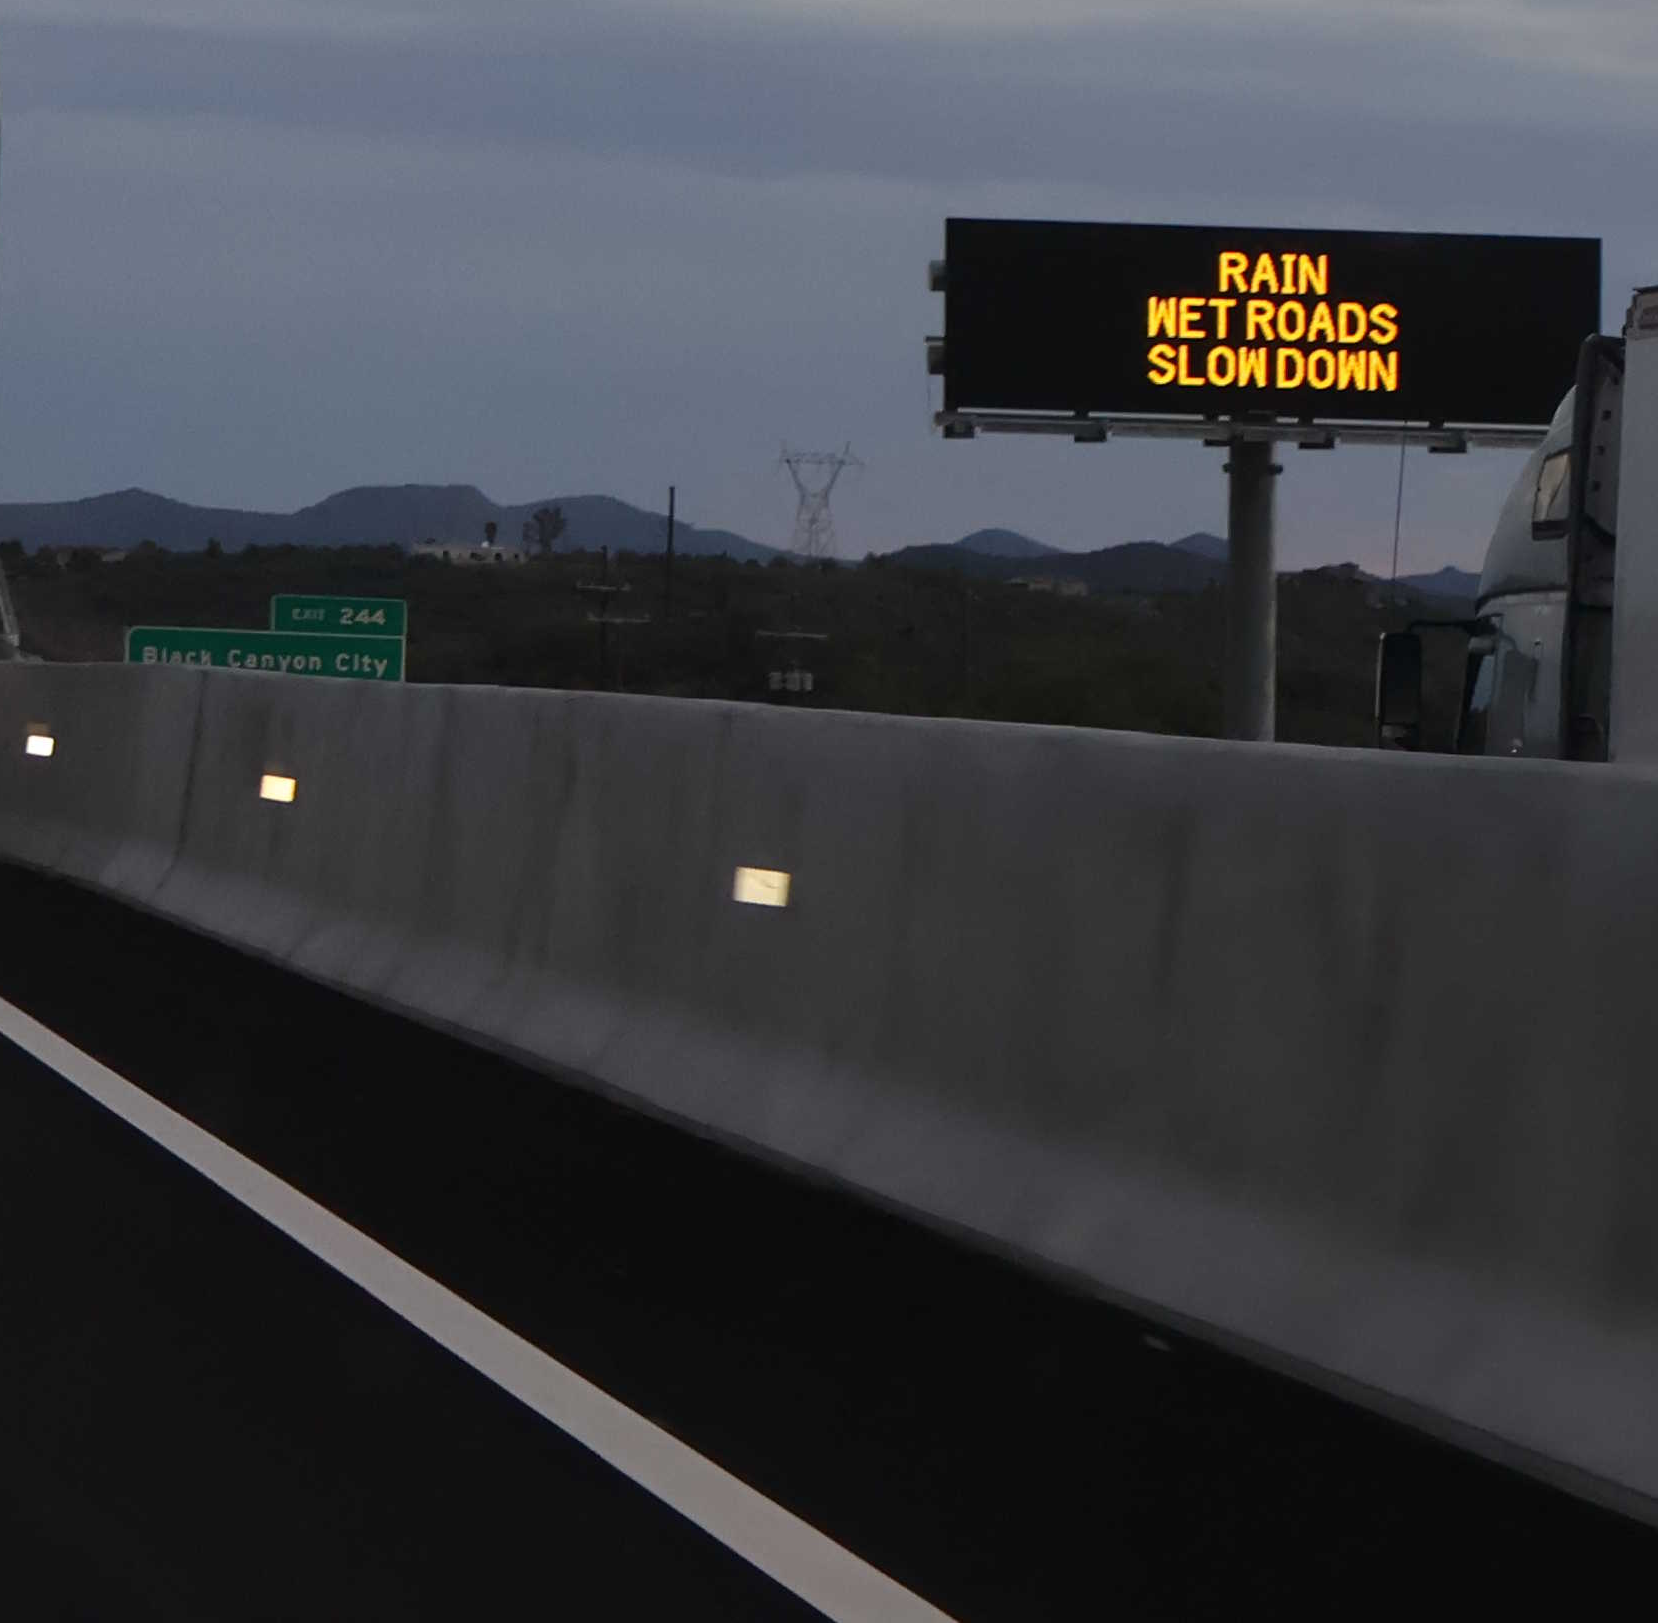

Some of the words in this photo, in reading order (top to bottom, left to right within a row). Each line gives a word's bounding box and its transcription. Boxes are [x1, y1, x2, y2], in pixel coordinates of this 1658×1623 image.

[1218, 251, 1328, 295] RAIN
[1146, 296, 1238, 340] WET
[1245, 299, 1399, 345] ROADS
[1146, 343, 1268, 388] SLOW
[1276, 347, 1399, 392] DOWN
[292, 607, 325, 621] EXIT
[339, 607, 387, 625] 244
[141, 646, 212, 667] Black
[226, 648, 323, 674] Canyon
[335, 653, 388, 678] City
